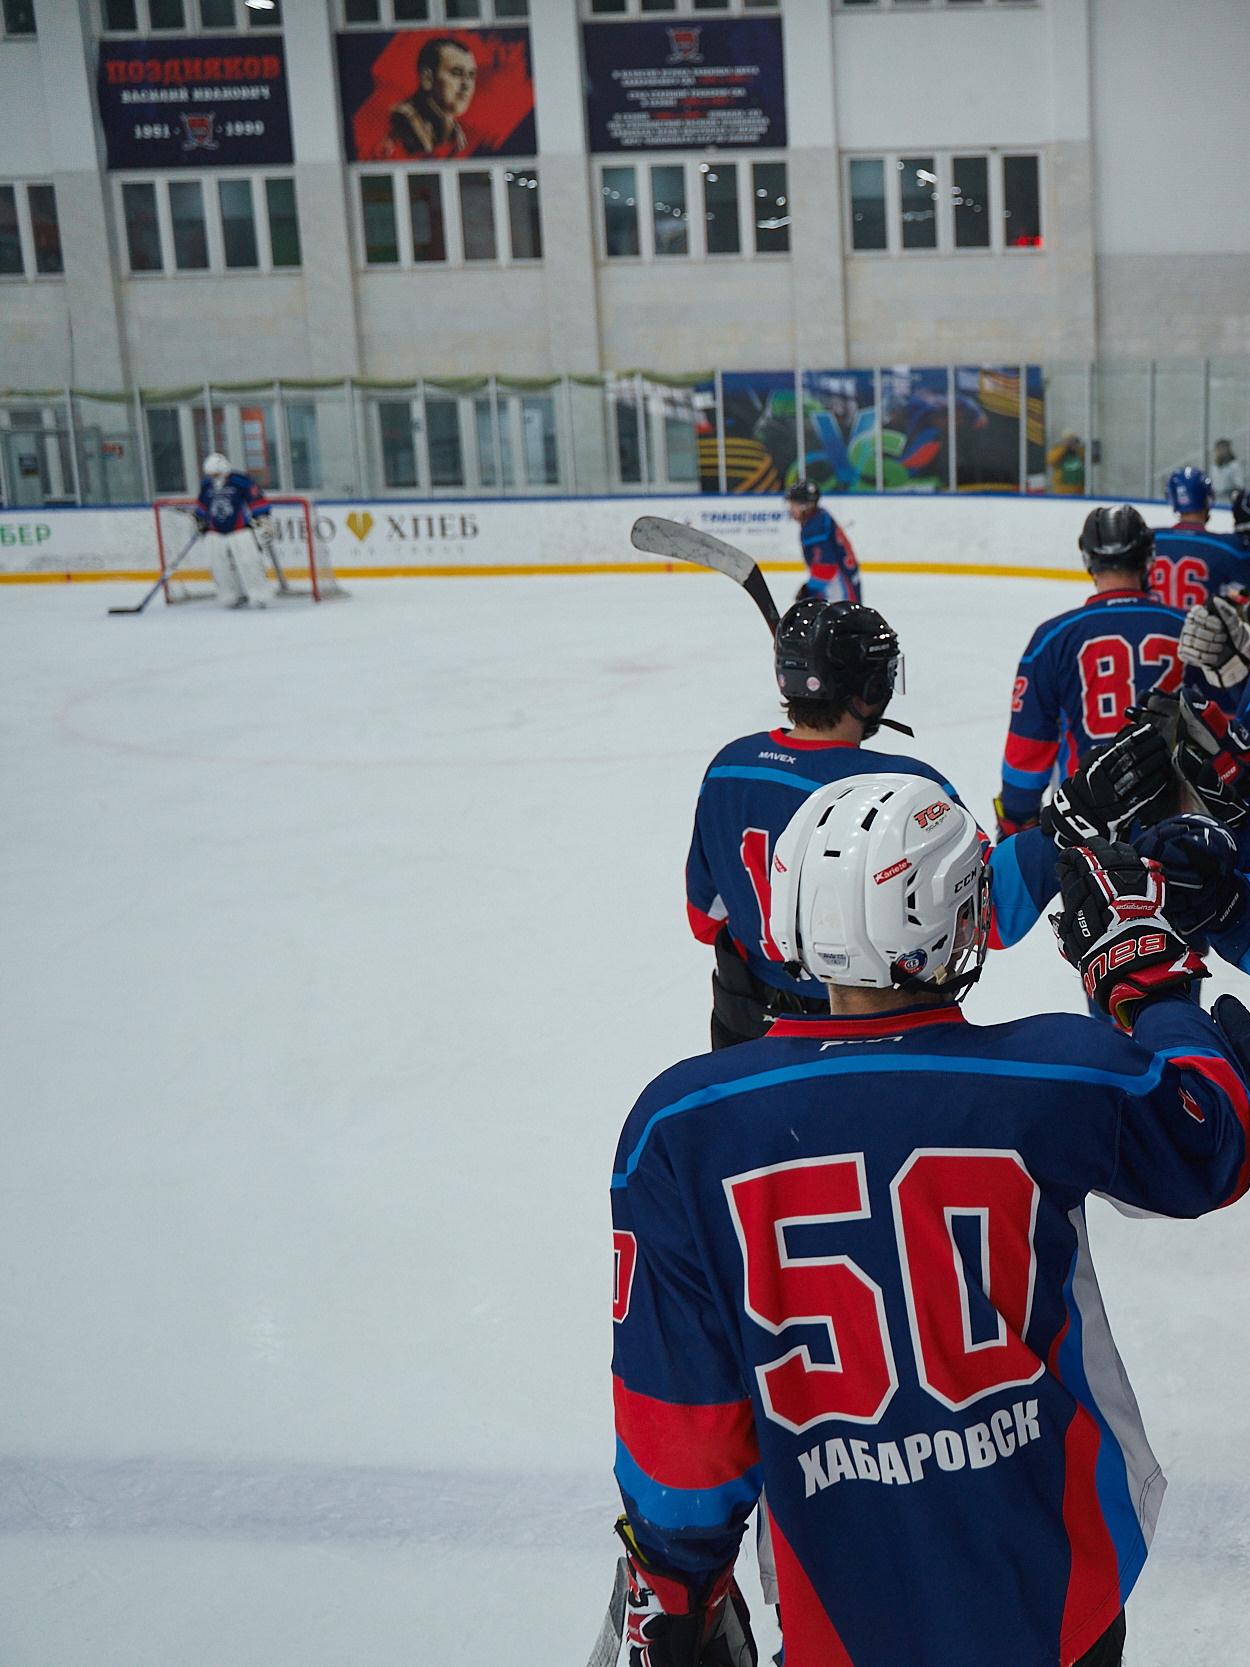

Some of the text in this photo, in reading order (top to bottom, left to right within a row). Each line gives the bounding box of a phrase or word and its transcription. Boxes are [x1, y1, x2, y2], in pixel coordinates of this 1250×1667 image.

[106, 55, 280, 85] ПОЗДНЯКОВ
[1077, 633, 1186, 740] 82
[758, 751, 797, 764] MAVEX
[954, 867, 977, 894] CCM
[1084, 933, 1167, 1000] BAU
[722, 1148, 1046, 1433] 50
[797, 1398, 1041, 1498] ХАБАРОВСК
